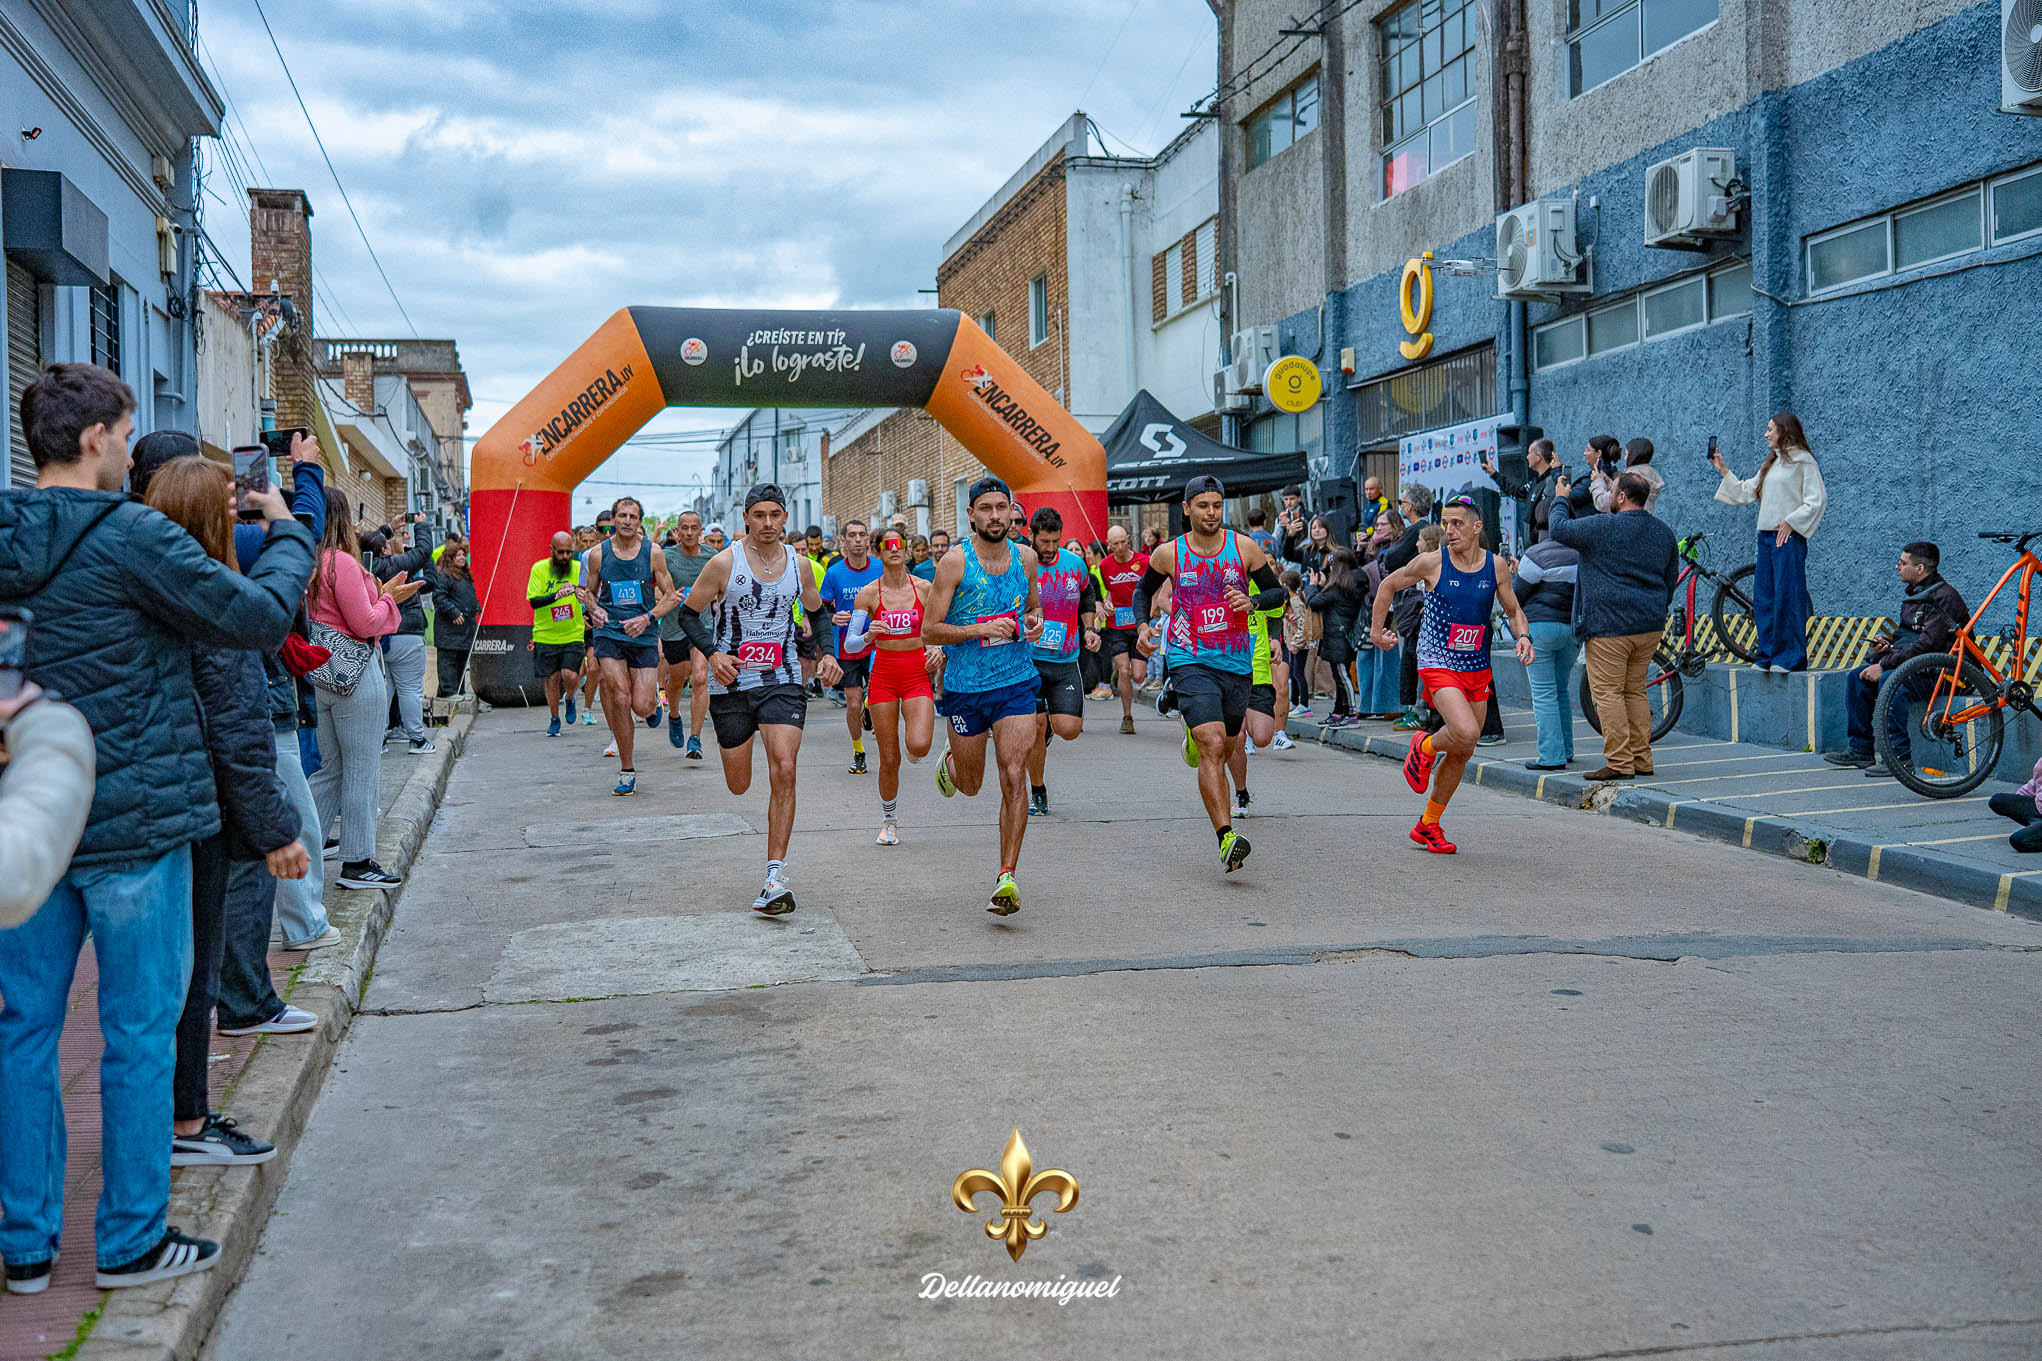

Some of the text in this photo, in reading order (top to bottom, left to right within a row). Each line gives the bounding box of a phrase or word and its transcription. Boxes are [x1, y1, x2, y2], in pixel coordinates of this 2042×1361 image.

[746, 327, 846, 346] ¿CREÍSTE EN TÍ?
[1275, 361, 1316, 380] guadalupe
[1107, 475, 1170, 490] COTT
[618, 587, 636, 599] 413
[553, 605, 570, 618] 245
[1201, 606, 1225, 625] 199
[887, 612, 911, 628] 178
[1040, 628, 1062, 643] 425
[1454, 628, 1480, 643] 207
[744, 646, 776, 663] 234
